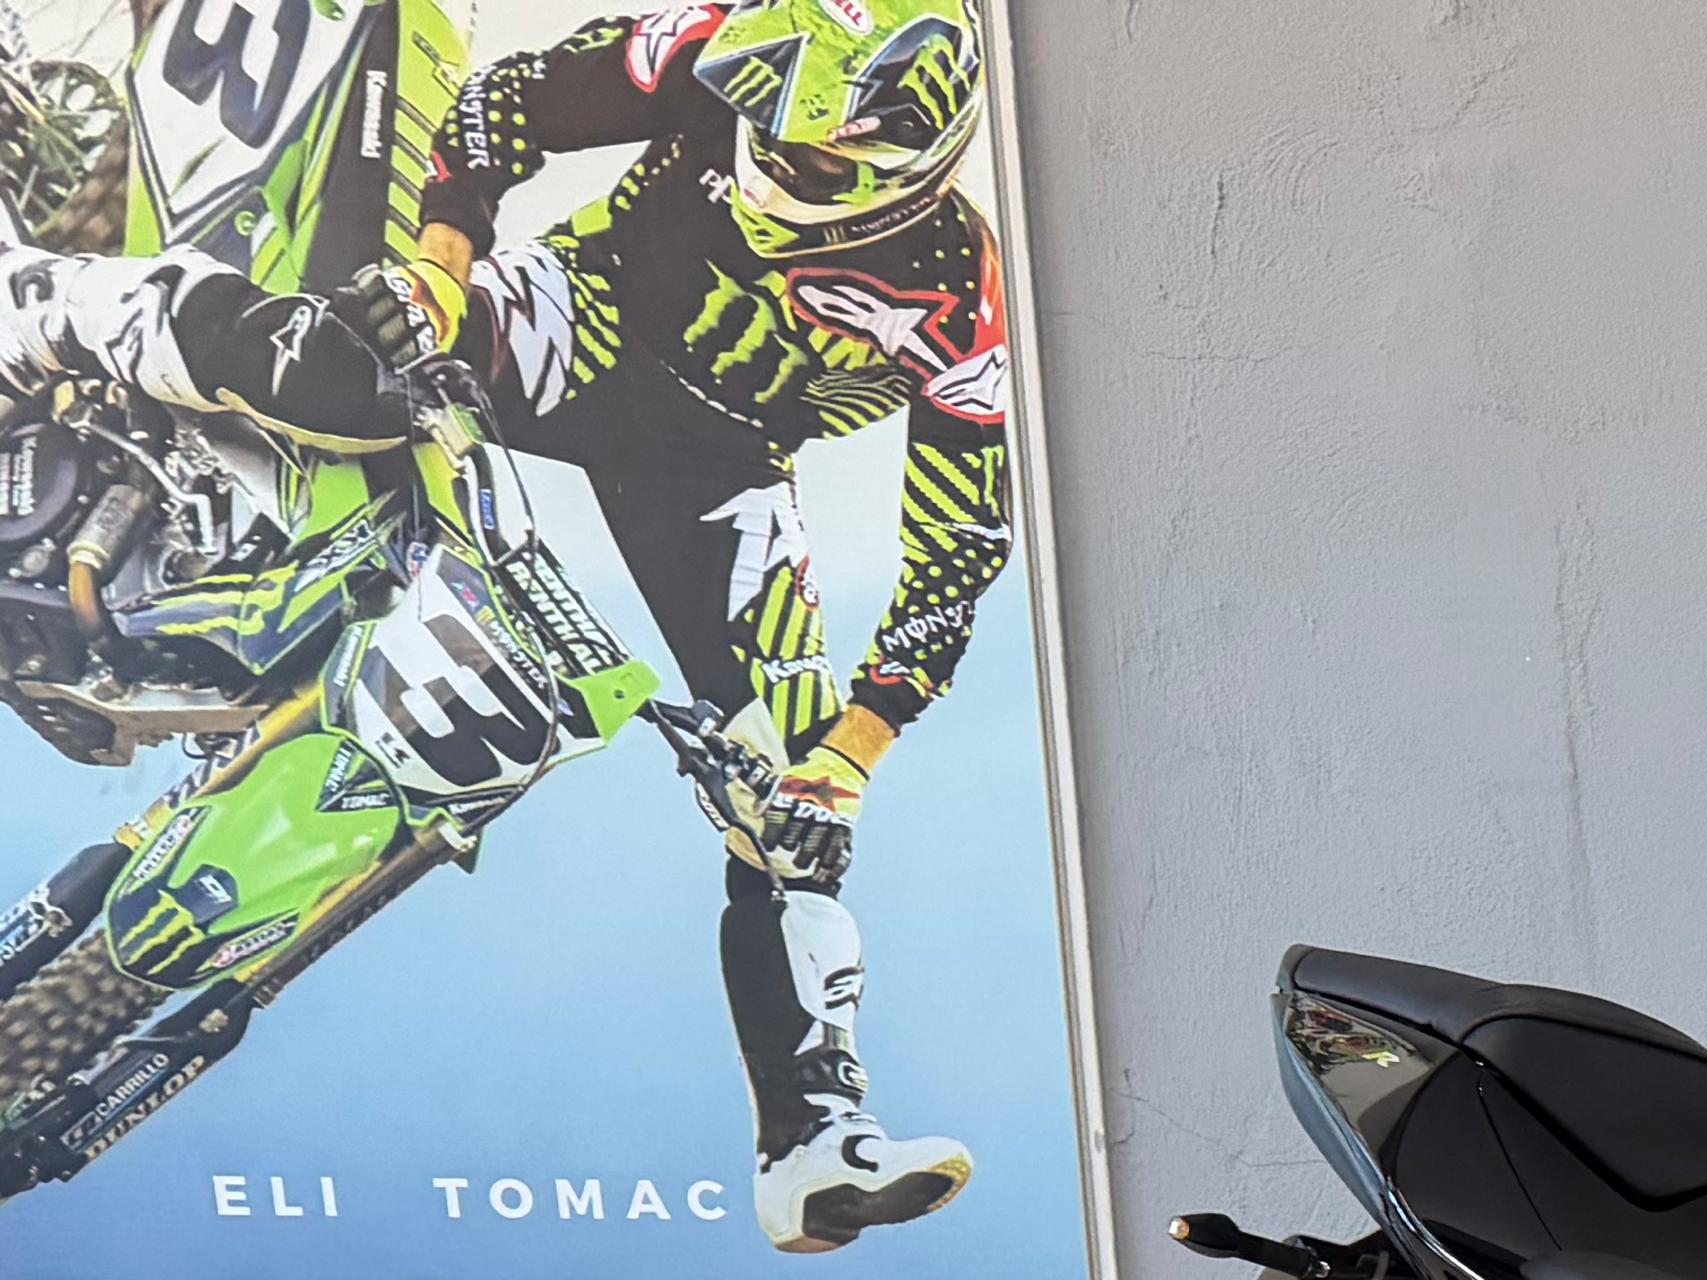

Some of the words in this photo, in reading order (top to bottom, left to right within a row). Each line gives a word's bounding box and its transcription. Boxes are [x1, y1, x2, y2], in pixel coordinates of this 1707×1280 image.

[366, 613, 557, 787] 3
[84, 1054, 208, 1161] DUNLOP
[95, 1051, 170, 1118] CARRILLO
[214, 1175, 340, 1218] ELI
[433, 1177, 730, 1220] TOMAC
